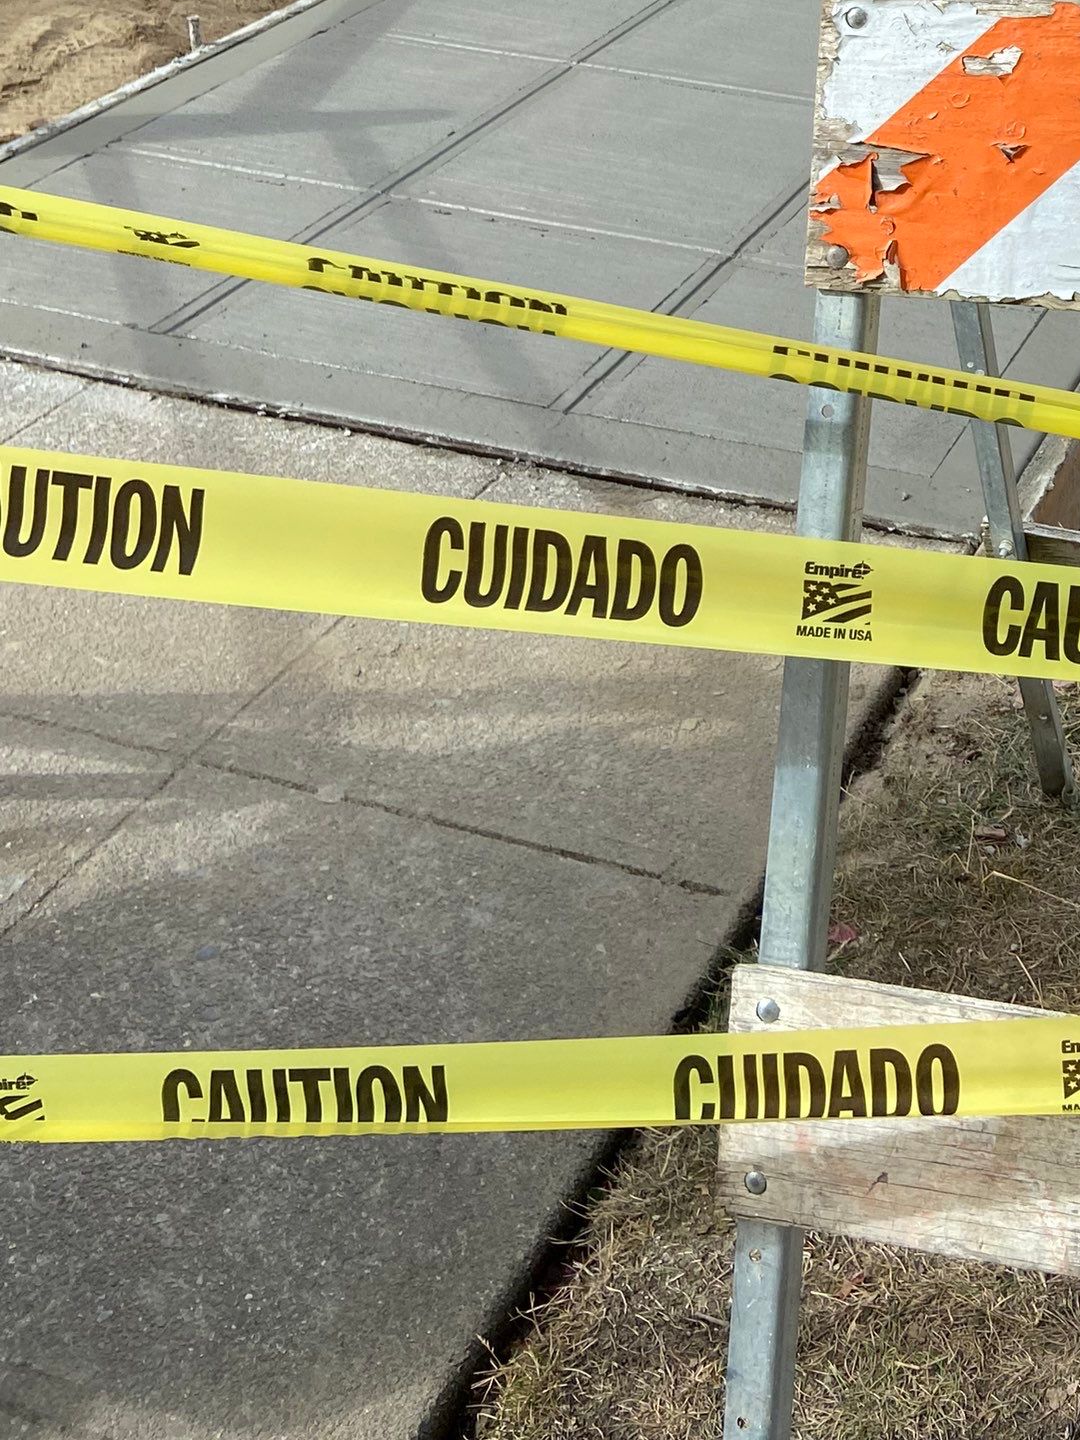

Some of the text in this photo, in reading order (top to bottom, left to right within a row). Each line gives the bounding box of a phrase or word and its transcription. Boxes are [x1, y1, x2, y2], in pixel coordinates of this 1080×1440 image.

[0, 464, 704, 628] UTION CUIDADO
[804, 561, 863, 579] Empire
[796, 625, 873, 642] MADE IN USA
[161, 1042, 961, 1124] CAUTION CUIDADO
